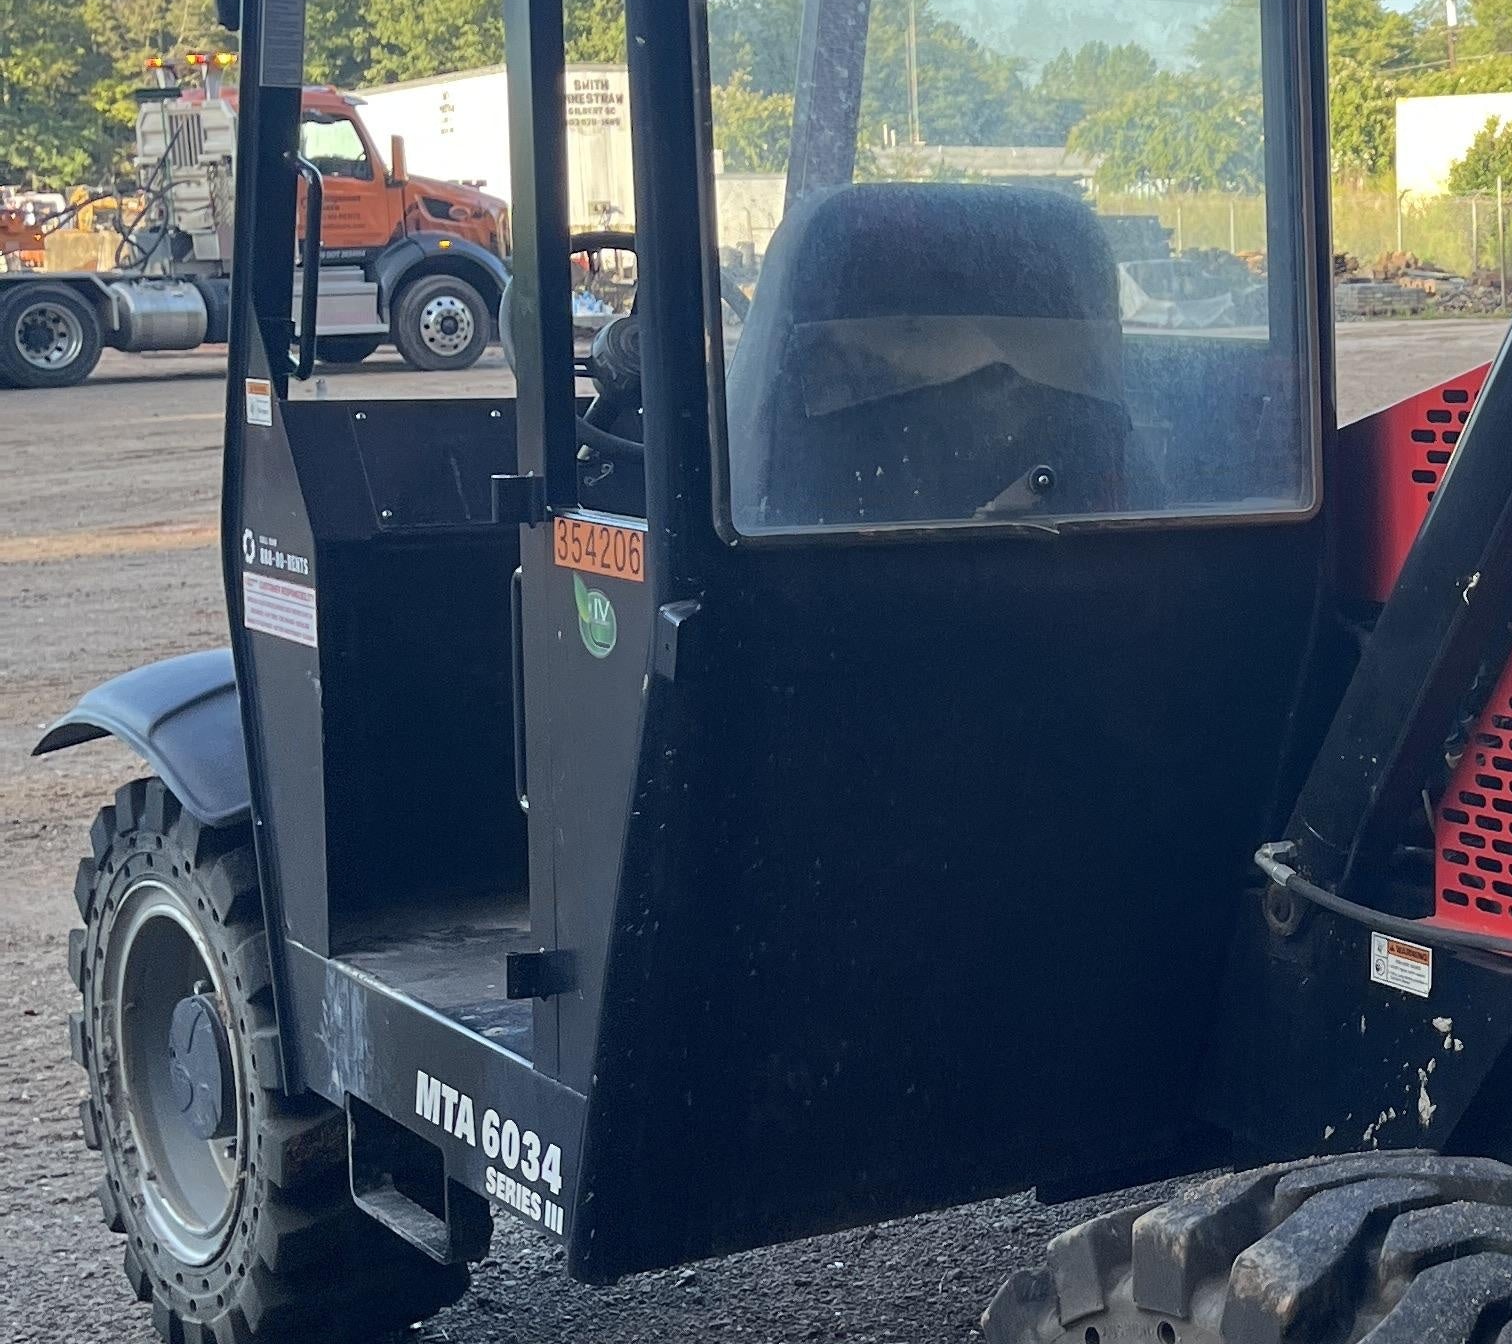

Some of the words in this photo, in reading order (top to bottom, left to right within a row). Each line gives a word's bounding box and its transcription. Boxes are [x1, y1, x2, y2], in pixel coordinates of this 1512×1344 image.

[574, 79, 609, 90] SMITH
[557, 519, 641, 576] 354206
[415, 1069, 476, 1148] MTA
[482, 1108, 563, 1196] 6034
[485, 1166, 542, 1222] SERIES
[544, 1199, 564, 1236] III
